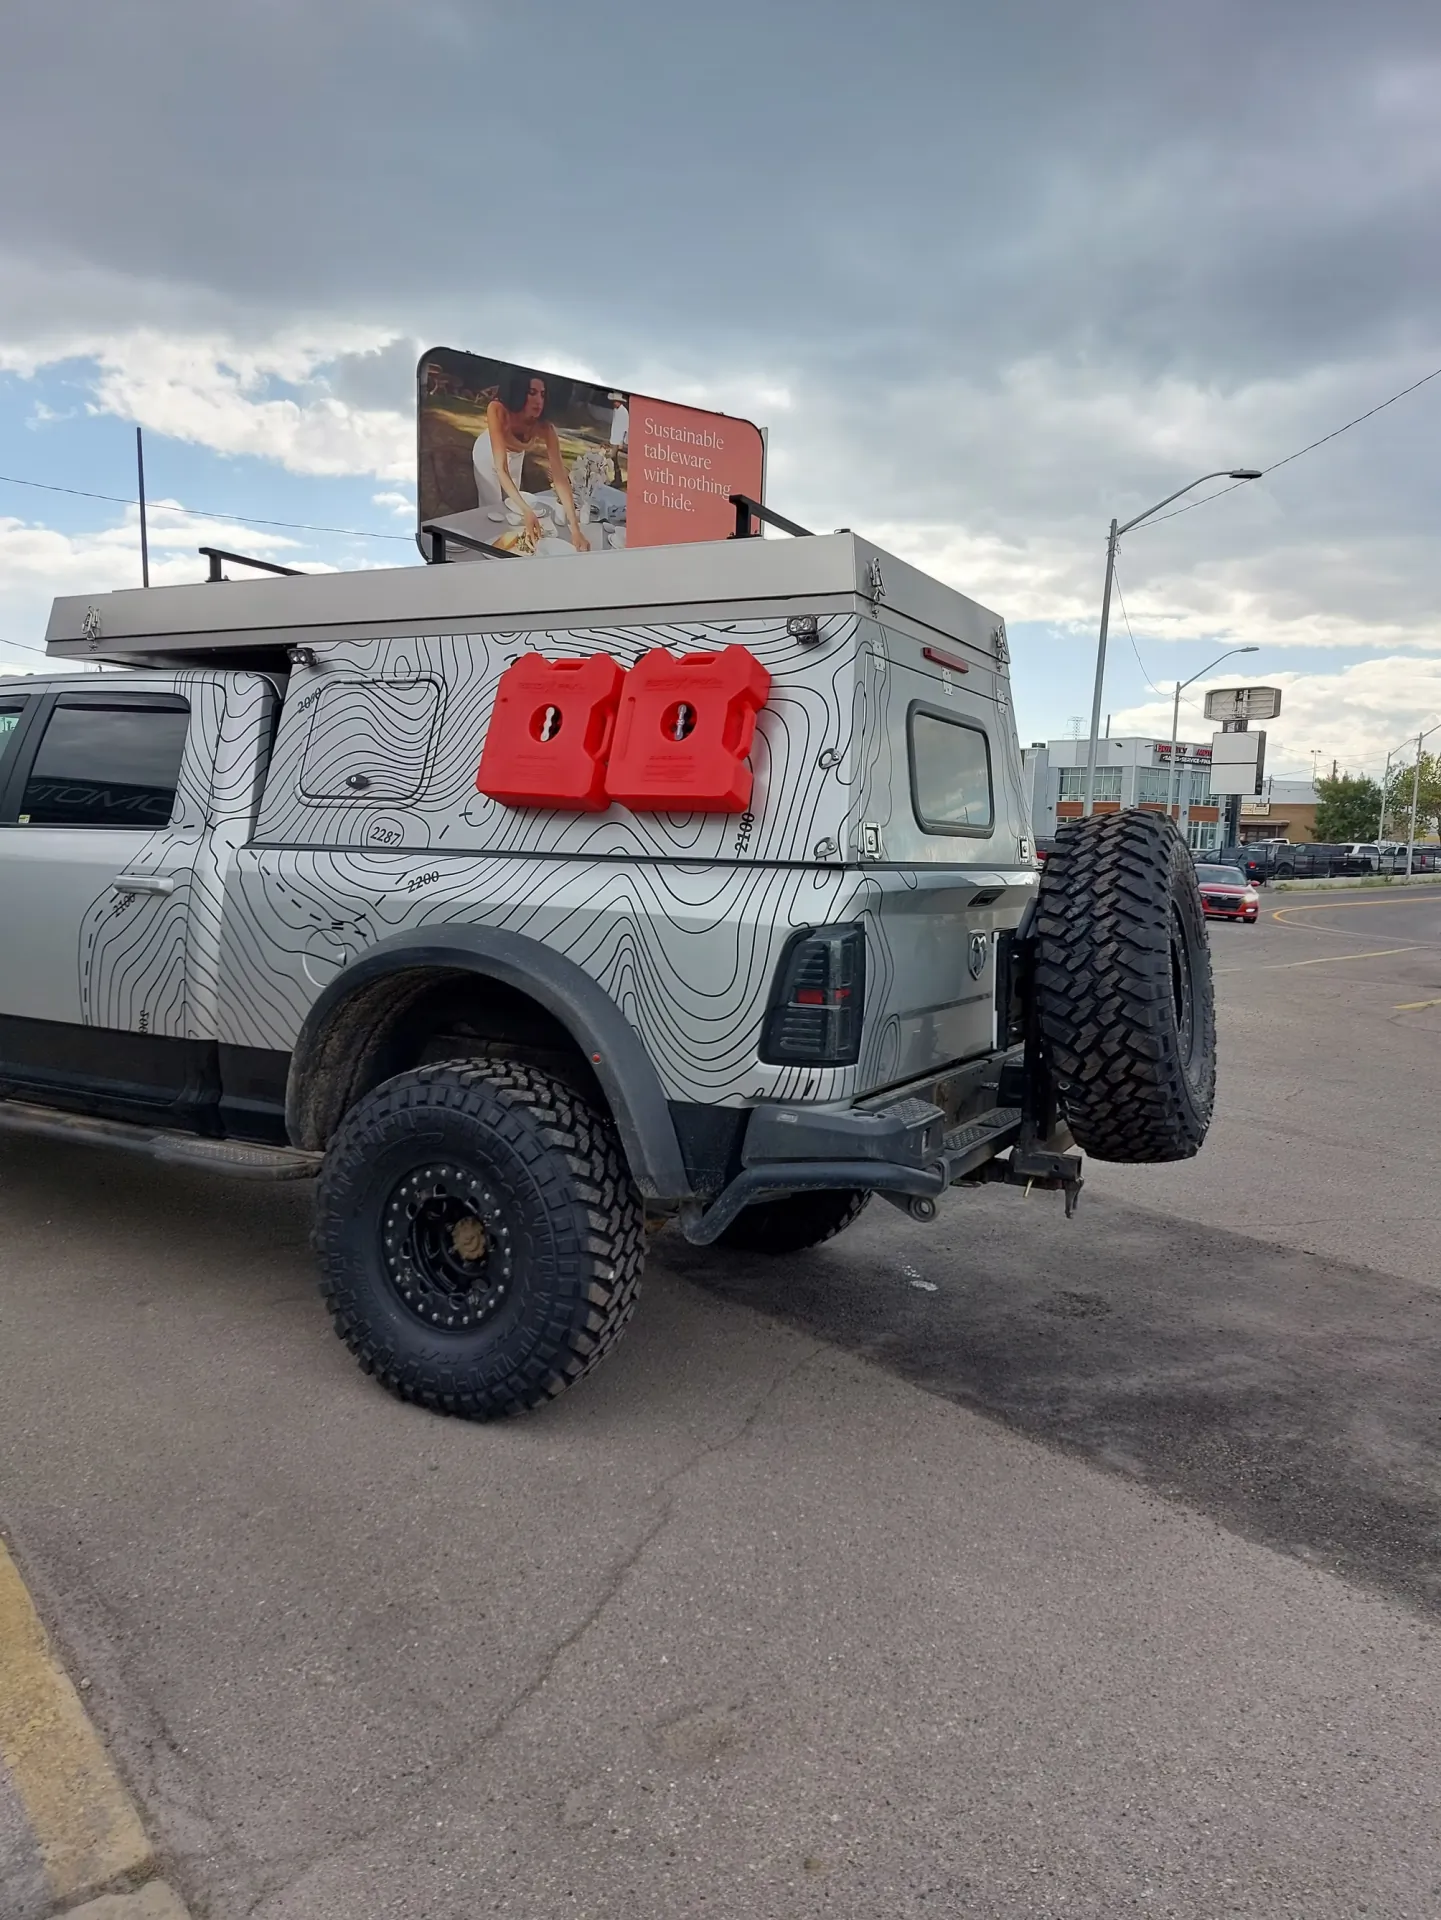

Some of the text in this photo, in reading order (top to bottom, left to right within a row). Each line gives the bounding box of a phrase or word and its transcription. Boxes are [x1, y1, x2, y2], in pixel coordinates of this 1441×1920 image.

[644, 417, 724, 450] Sustainable
[644, 443, 712, 470] tableware
[643, 467, 732, 500] with nothing
[643, 489, 695, 512] to hide.
[370, 826, 401, 845] 2287
[734, 812, 755, 853] 2100
[407, 870, 440, 894] 2200
